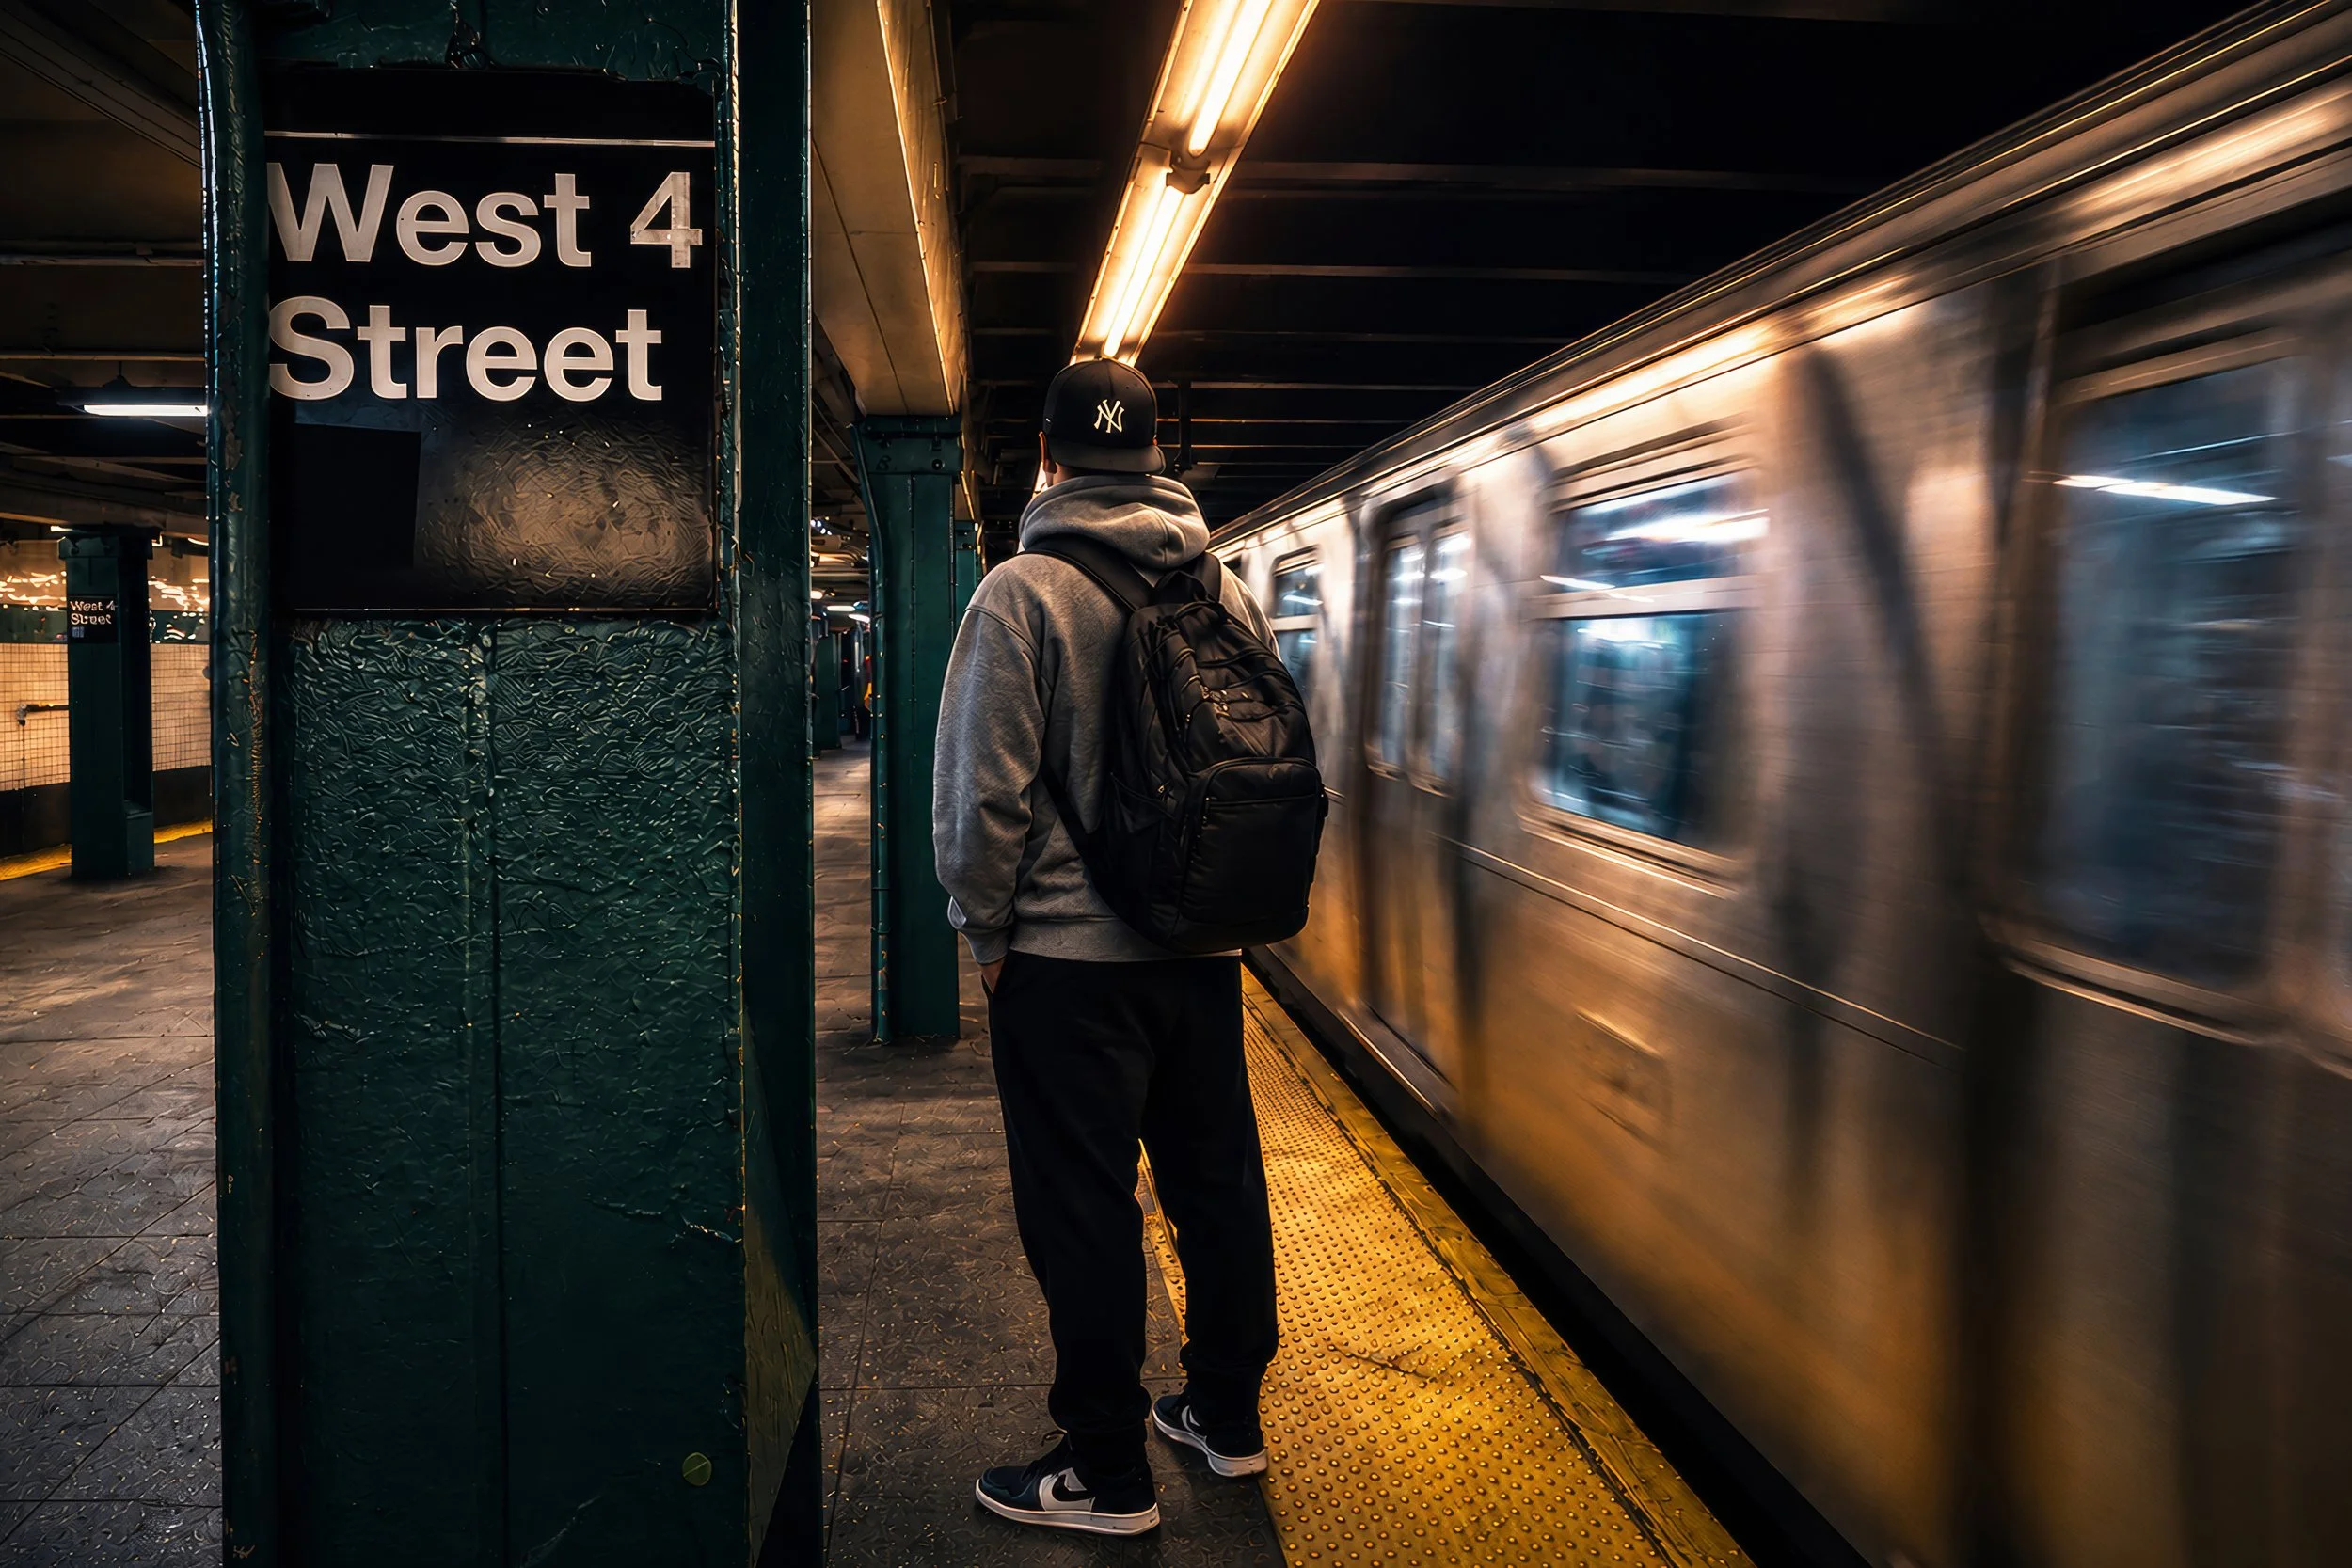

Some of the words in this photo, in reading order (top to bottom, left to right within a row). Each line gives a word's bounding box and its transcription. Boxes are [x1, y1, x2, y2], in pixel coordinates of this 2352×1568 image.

[266, 162, 592, 268] West
[629, 171, 703, 269] 4
[268, 295, 663, 402] Street
[1093, 399, 1125, 433] NY
